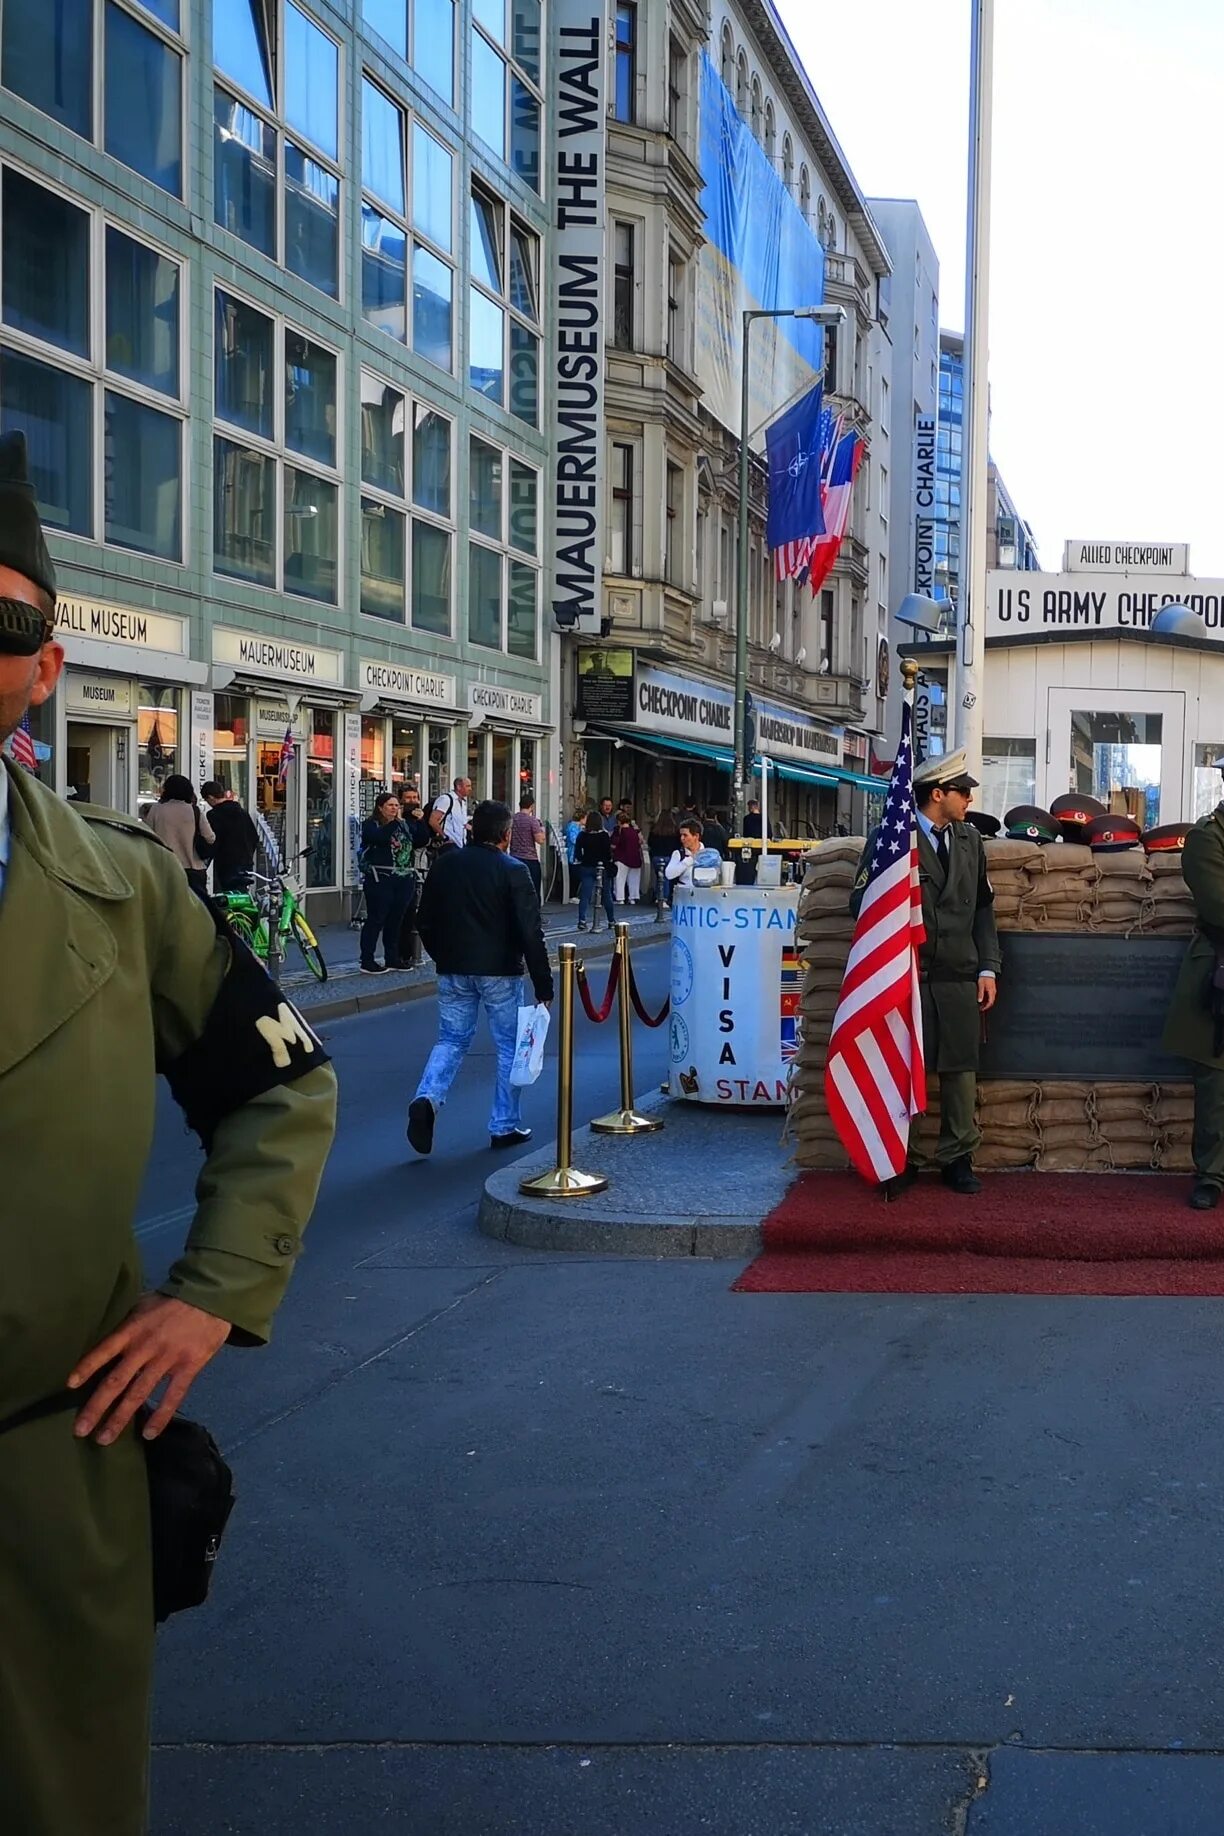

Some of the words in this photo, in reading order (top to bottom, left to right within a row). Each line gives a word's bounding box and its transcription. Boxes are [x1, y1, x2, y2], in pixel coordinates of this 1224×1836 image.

[558, 17, 599, 138] WALL
[557, 151, 597, 230] THE
[555, 254, 599, 616] MAUERMUSEUM
[916, 420, 935, 508] CHARLIE
[1080, 545, 1111, 564] ALLIED
[1115, 546, 1174, 566] CHECKPOINT
[91, 608, 147, 643] MUSEUM
[998, 589, 1030, 622] US
[1043, 590, 1107, 625] ARMY
[239, 639, 315, 675] MAUERMUSEUM
[82, 685, 115, 701] MUSEUM
[366, 665, 413, 692] CHECKPOINT
[415, 675, 445, 699] CHARLIE
[472, 687, 509, 711] CHECKPOINT
[509, 695, 533, 715] CHARLIE
[639, 682, 698, 723] CHECKPOINT
[699, 698, 731, 730] CHARLIE
[915, 694, 929, 749] HAUS
[717, 944, 737, 1065] VISA
